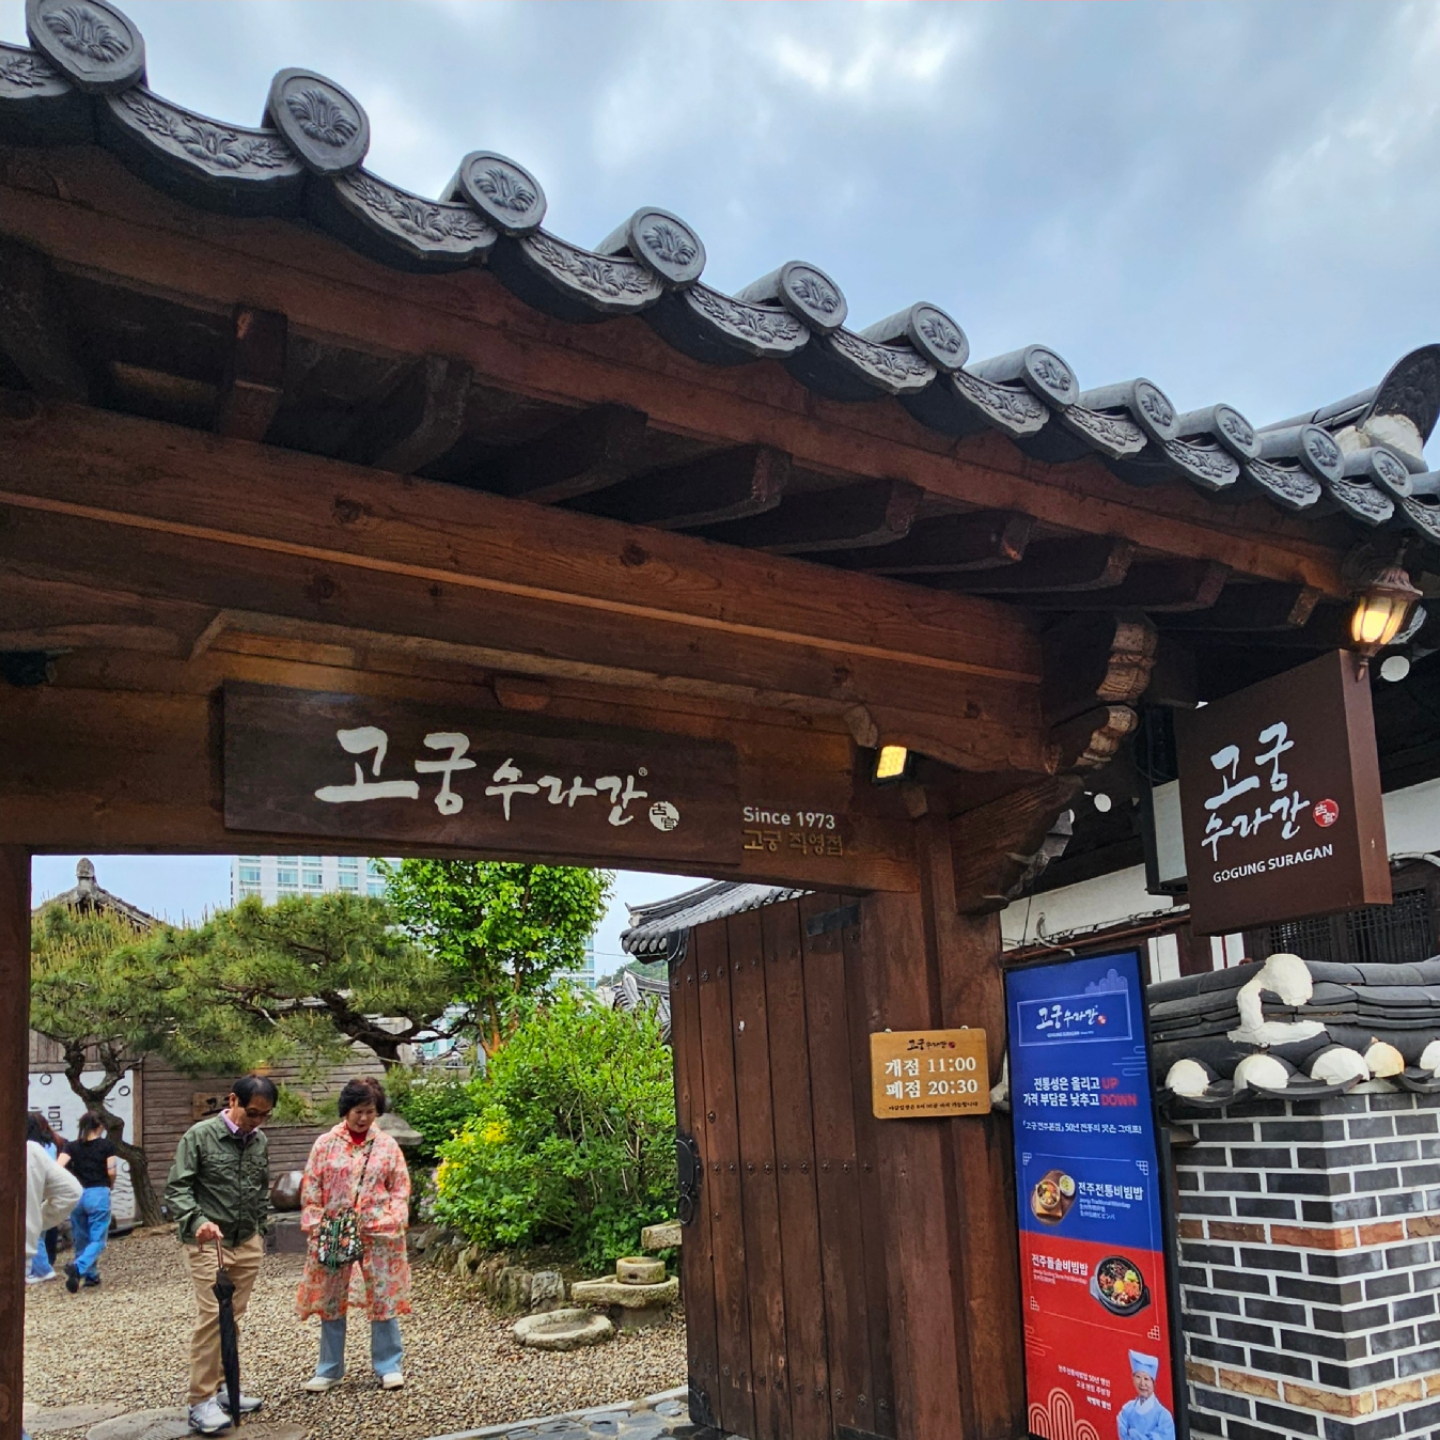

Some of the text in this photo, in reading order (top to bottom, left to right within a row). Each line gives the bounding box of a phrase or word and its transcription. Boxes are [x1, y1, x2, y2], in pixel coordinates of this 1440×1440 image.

[1204, 721, 1294, 810] 고궁
[743, 806, 835, 829] Since 1973
[1201, 791, 1310, 861] 수라간
[743, 830, 782, 851] 고궁
[1214, 844, 1333, 883] GOGUNG SURAGAN
[885, 1057, 976, 1077] 개점 11:00
[886, 1079, 978, 1099] 폐점 20:30
[1034, 1077, 1119, 1091] 전통성은 올리고 UP
[1023, 1093, 1038, 1106] 가격
[1040, 1094, 1068, 1106] 부담은
[1101, 1094, 1137, 1106] DOWN
